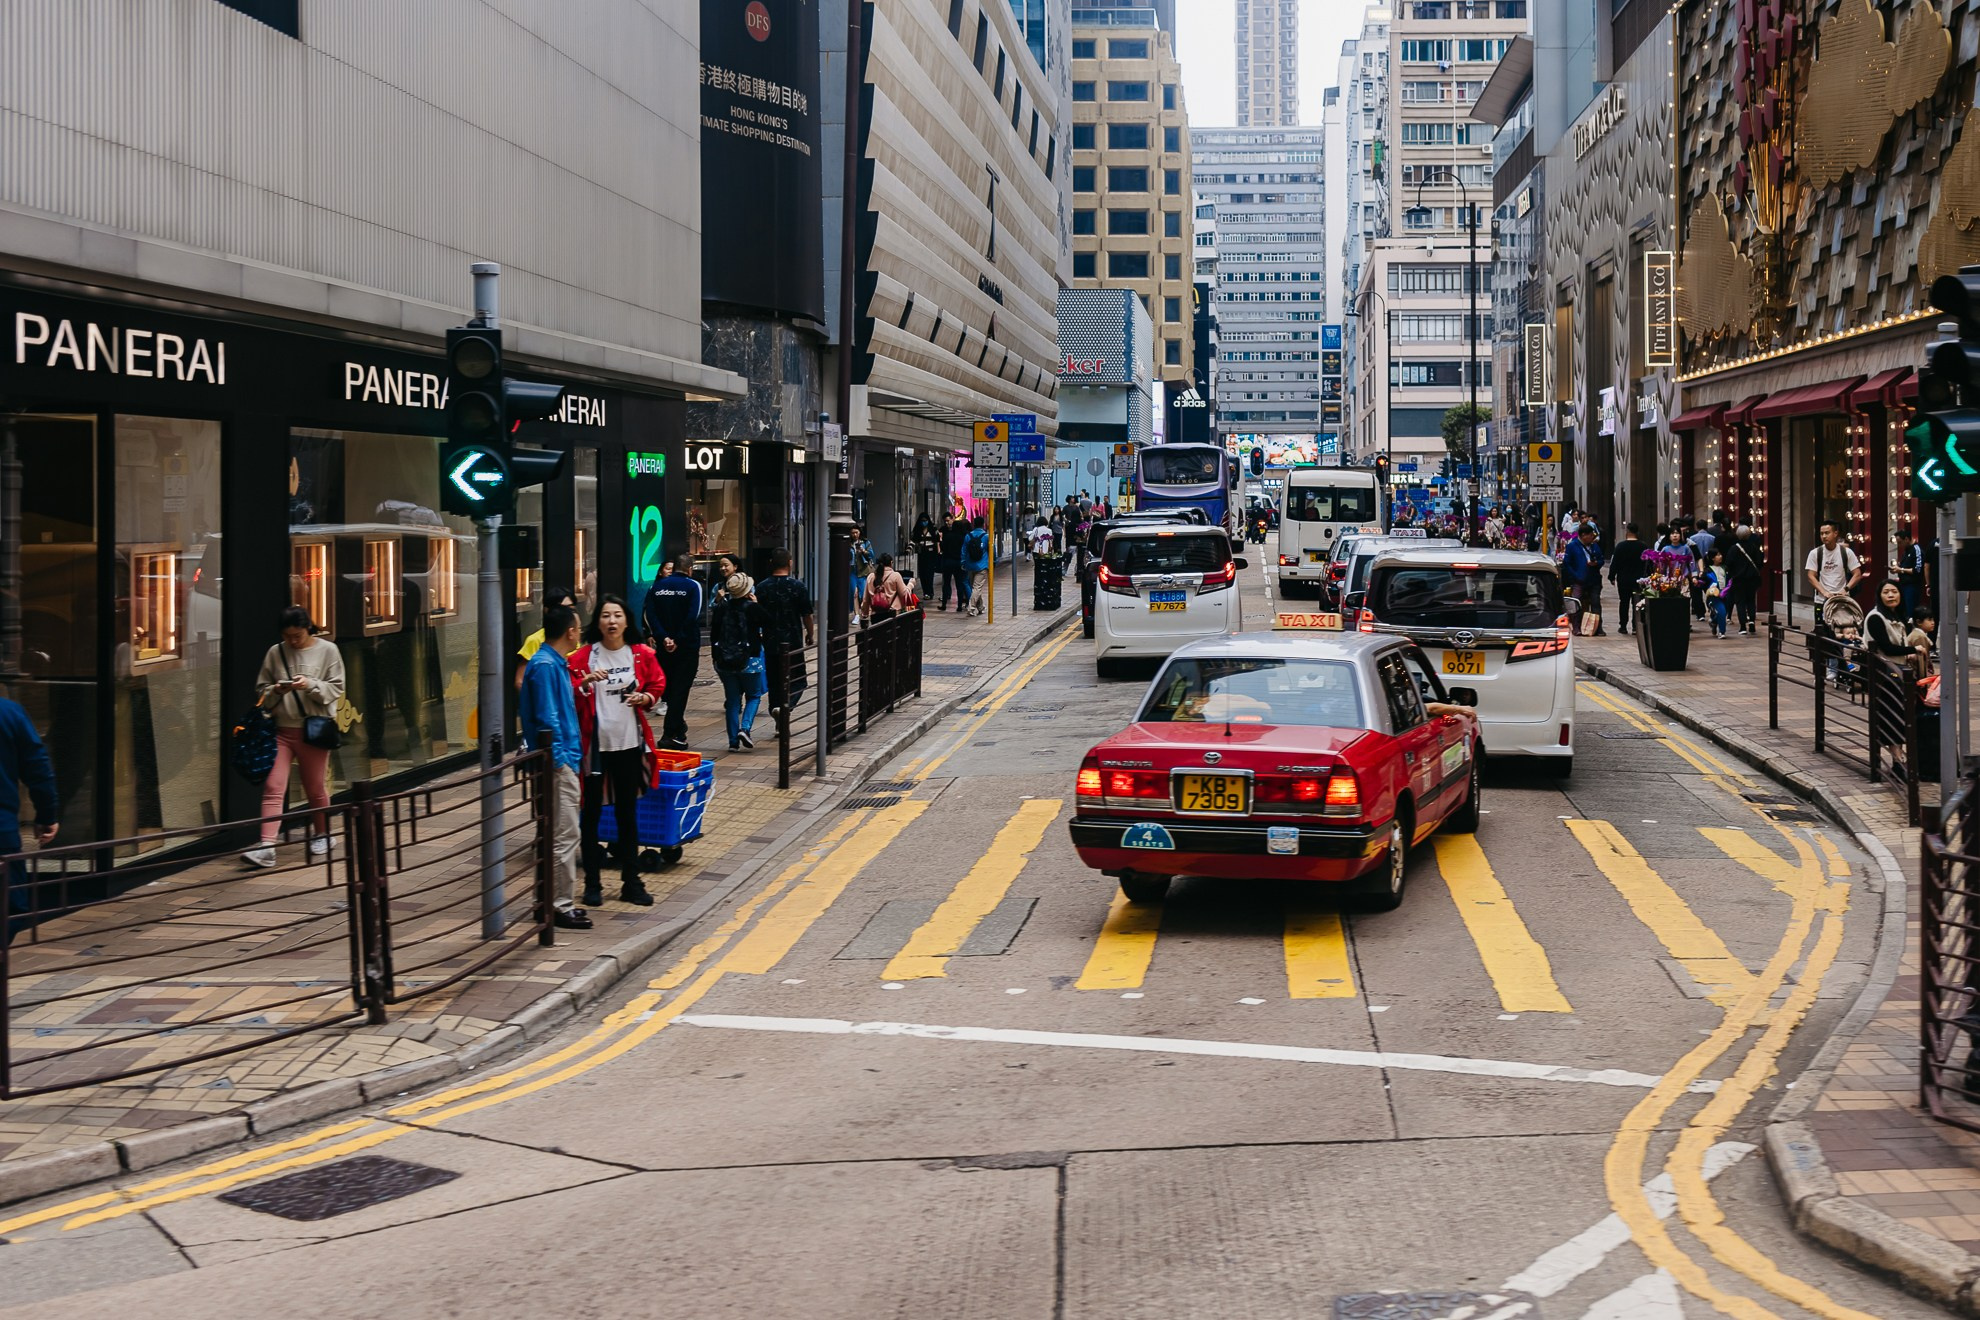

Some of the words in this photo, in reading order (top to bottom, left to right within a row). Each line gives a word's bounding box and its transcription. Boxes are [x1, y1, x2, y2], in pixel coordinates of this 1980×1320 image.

[747, 11, 769, 32] DFS
[730, 105, 755, 122] HONG
[757, 112, 788, 130] KONG'S
[731, 122, 775, 143] SHOPPING
[776, 133, 811, 157] DESTINATION
[1654, 298, 1666, 353] TIFFANY
[15, 312, 226, 385] PANERAI
[1531, 358, 1541, 396] TIFFANY
[540, 394, 606, 427] NERAI
[1173, 399, 1207, 408] adidas
[996, 443, 1002, 452] 7
[628, 457, 663, 474] PANERAI
[685, 447, 724, 470] LOT
[996, 456, 1002, 464] 7
[1550, 464, 1556, 472] 7
[1393, 529, 1424, 537] TAXI
[629, 505, 663, 583] 12
[1163, 602, 1186, 611] 7673
[1279, 614, 1336, 627] TAXI
[1454, 652, 1474, 663] YP
[1447, 663, 1480, 674] 9071
[1200, 777, 1227, 793] KB
[1187, 793, 1239, 809] 7309
[1142, 830, 1153, 841] 4
[1132, 840, 1164, 848] SEATS
